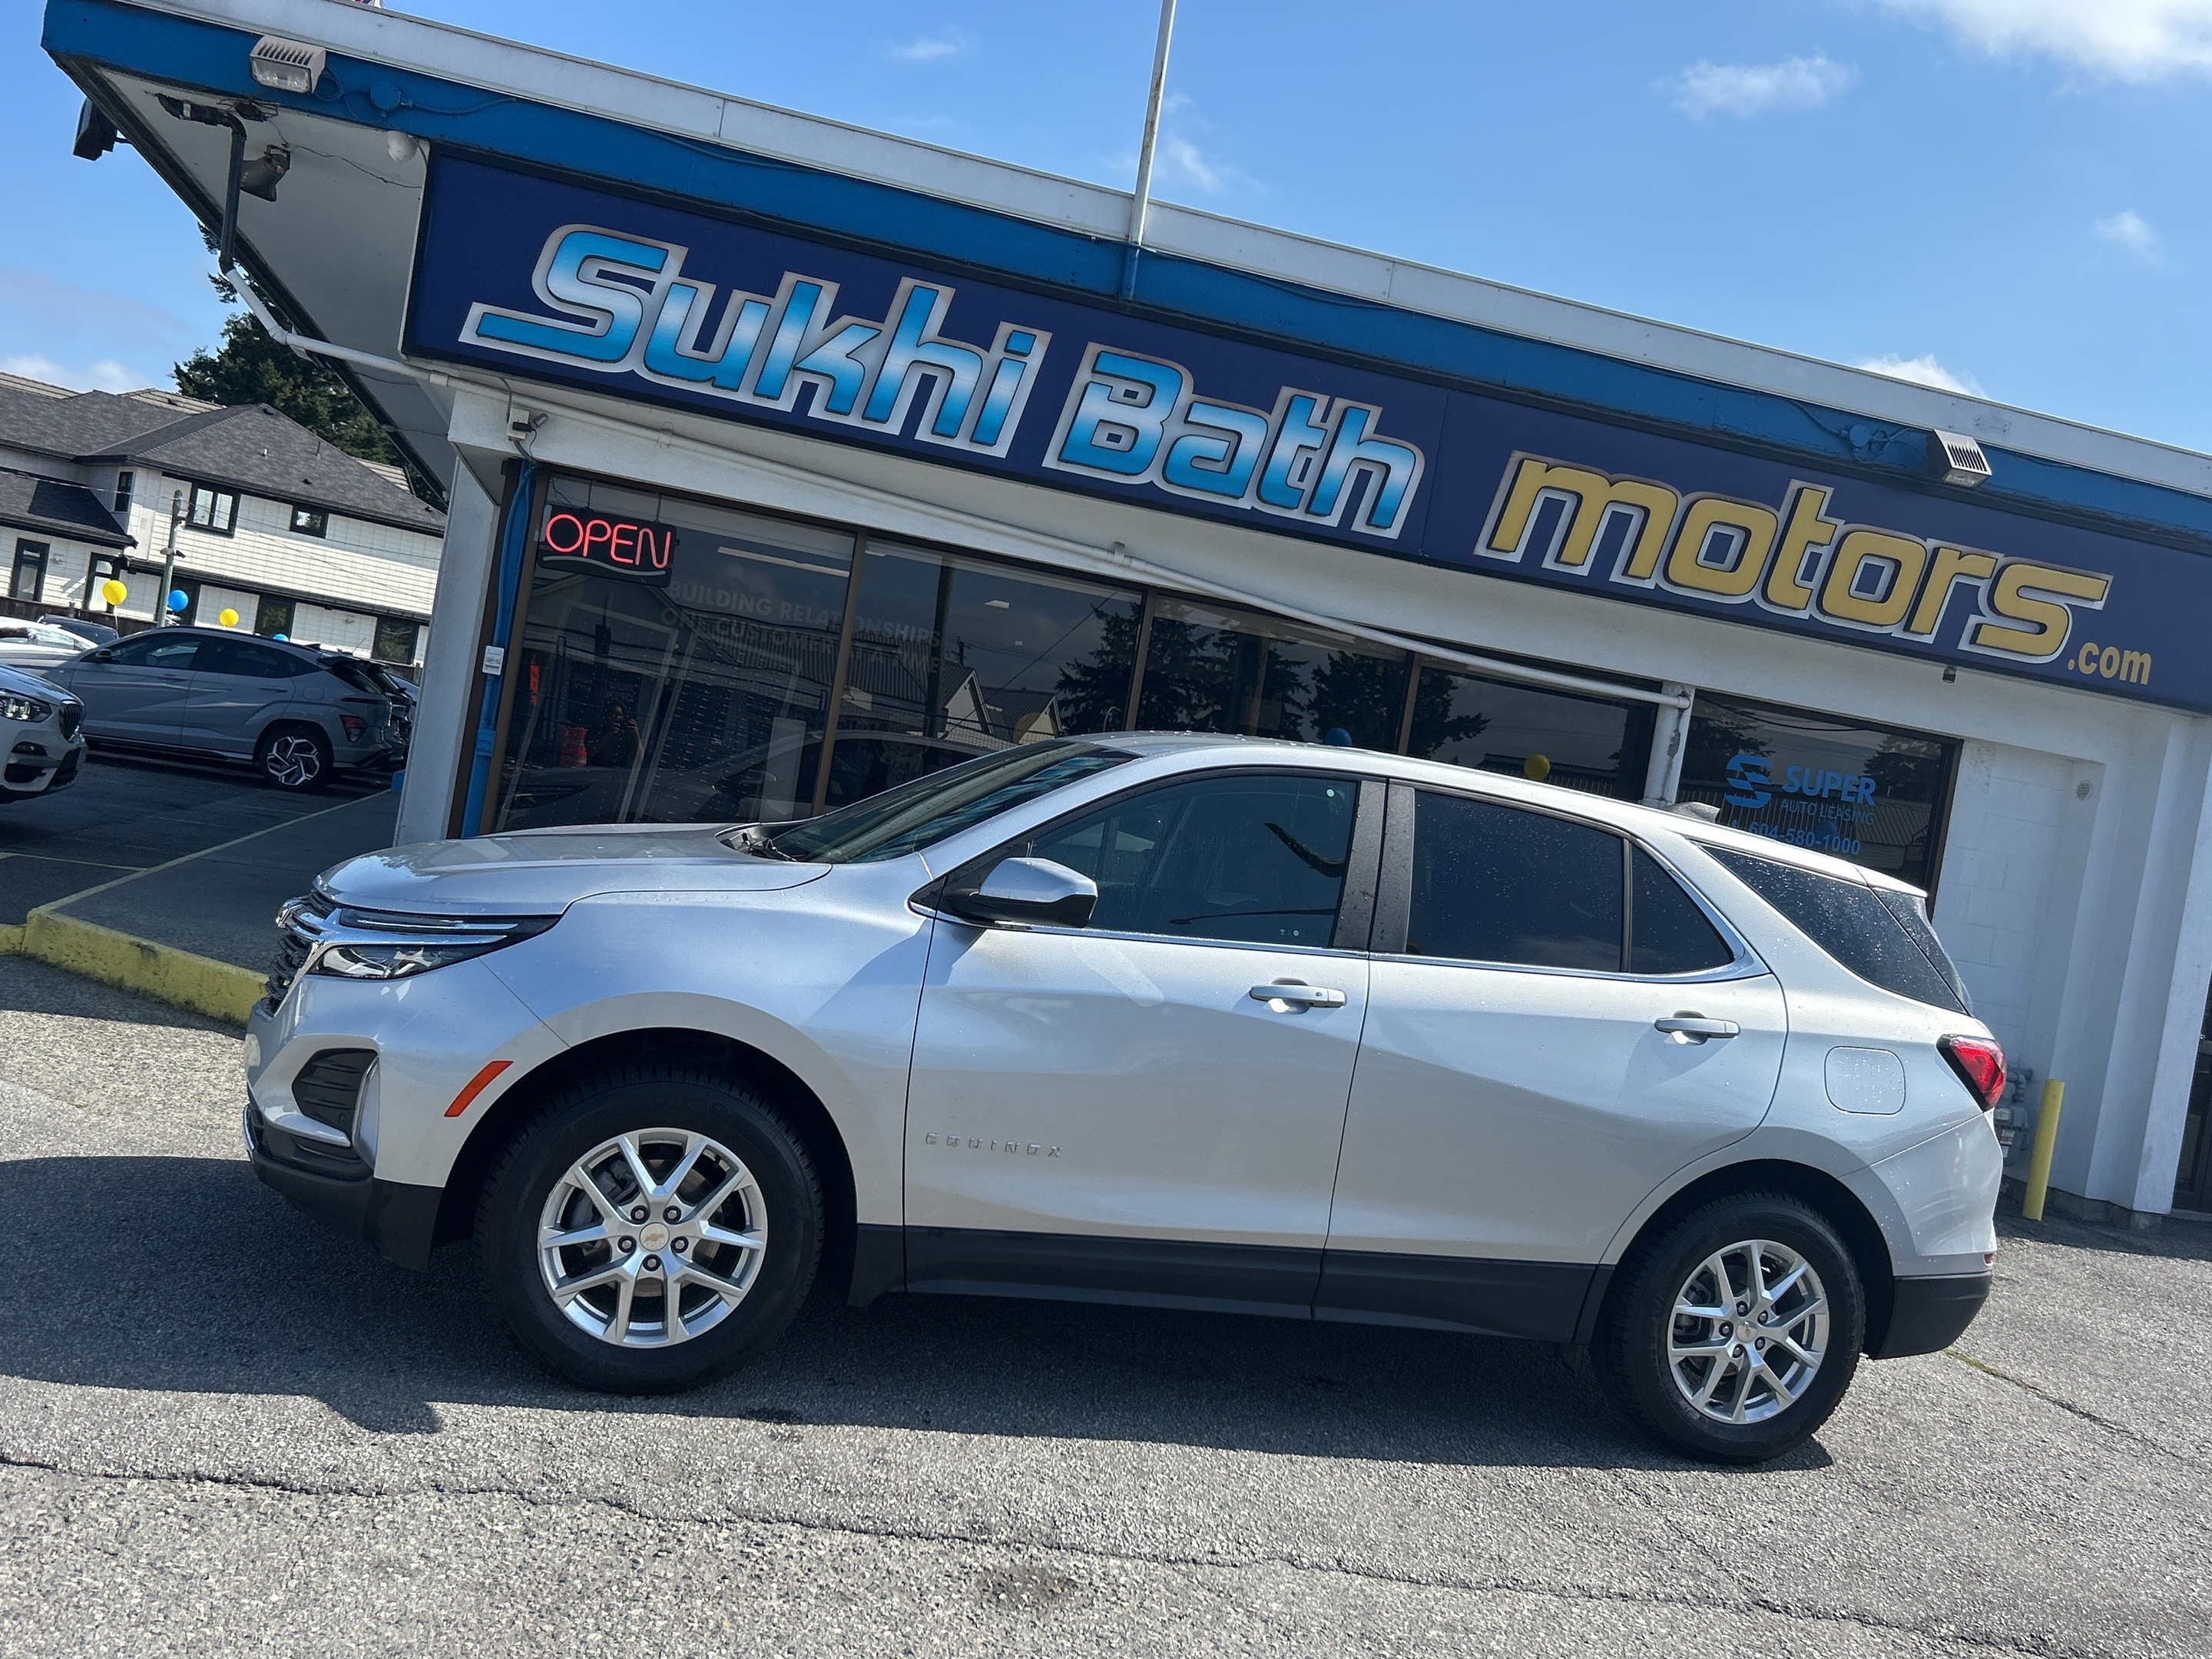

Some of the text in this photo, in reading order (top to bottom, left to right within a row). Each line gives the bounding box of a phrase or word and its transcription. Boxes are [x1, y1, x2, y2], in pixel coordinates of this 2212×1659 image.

[459, 224, 2151, 685] Sukhi Bath motors .com
[545, 513, 671, 569] OPEN
[669, 581, 942, 647] BUILDING RELATONSHIPS
[715, 617, 836, 654] CUSTOMER
[1781, 764, 1876, 806] SUPER
[1780, 797, 1874, 826] AUTO LEASING
[1749, 820, 1861, 855] 604-580-1000
[926, 1132, 1062, 1157] EQUINOX
